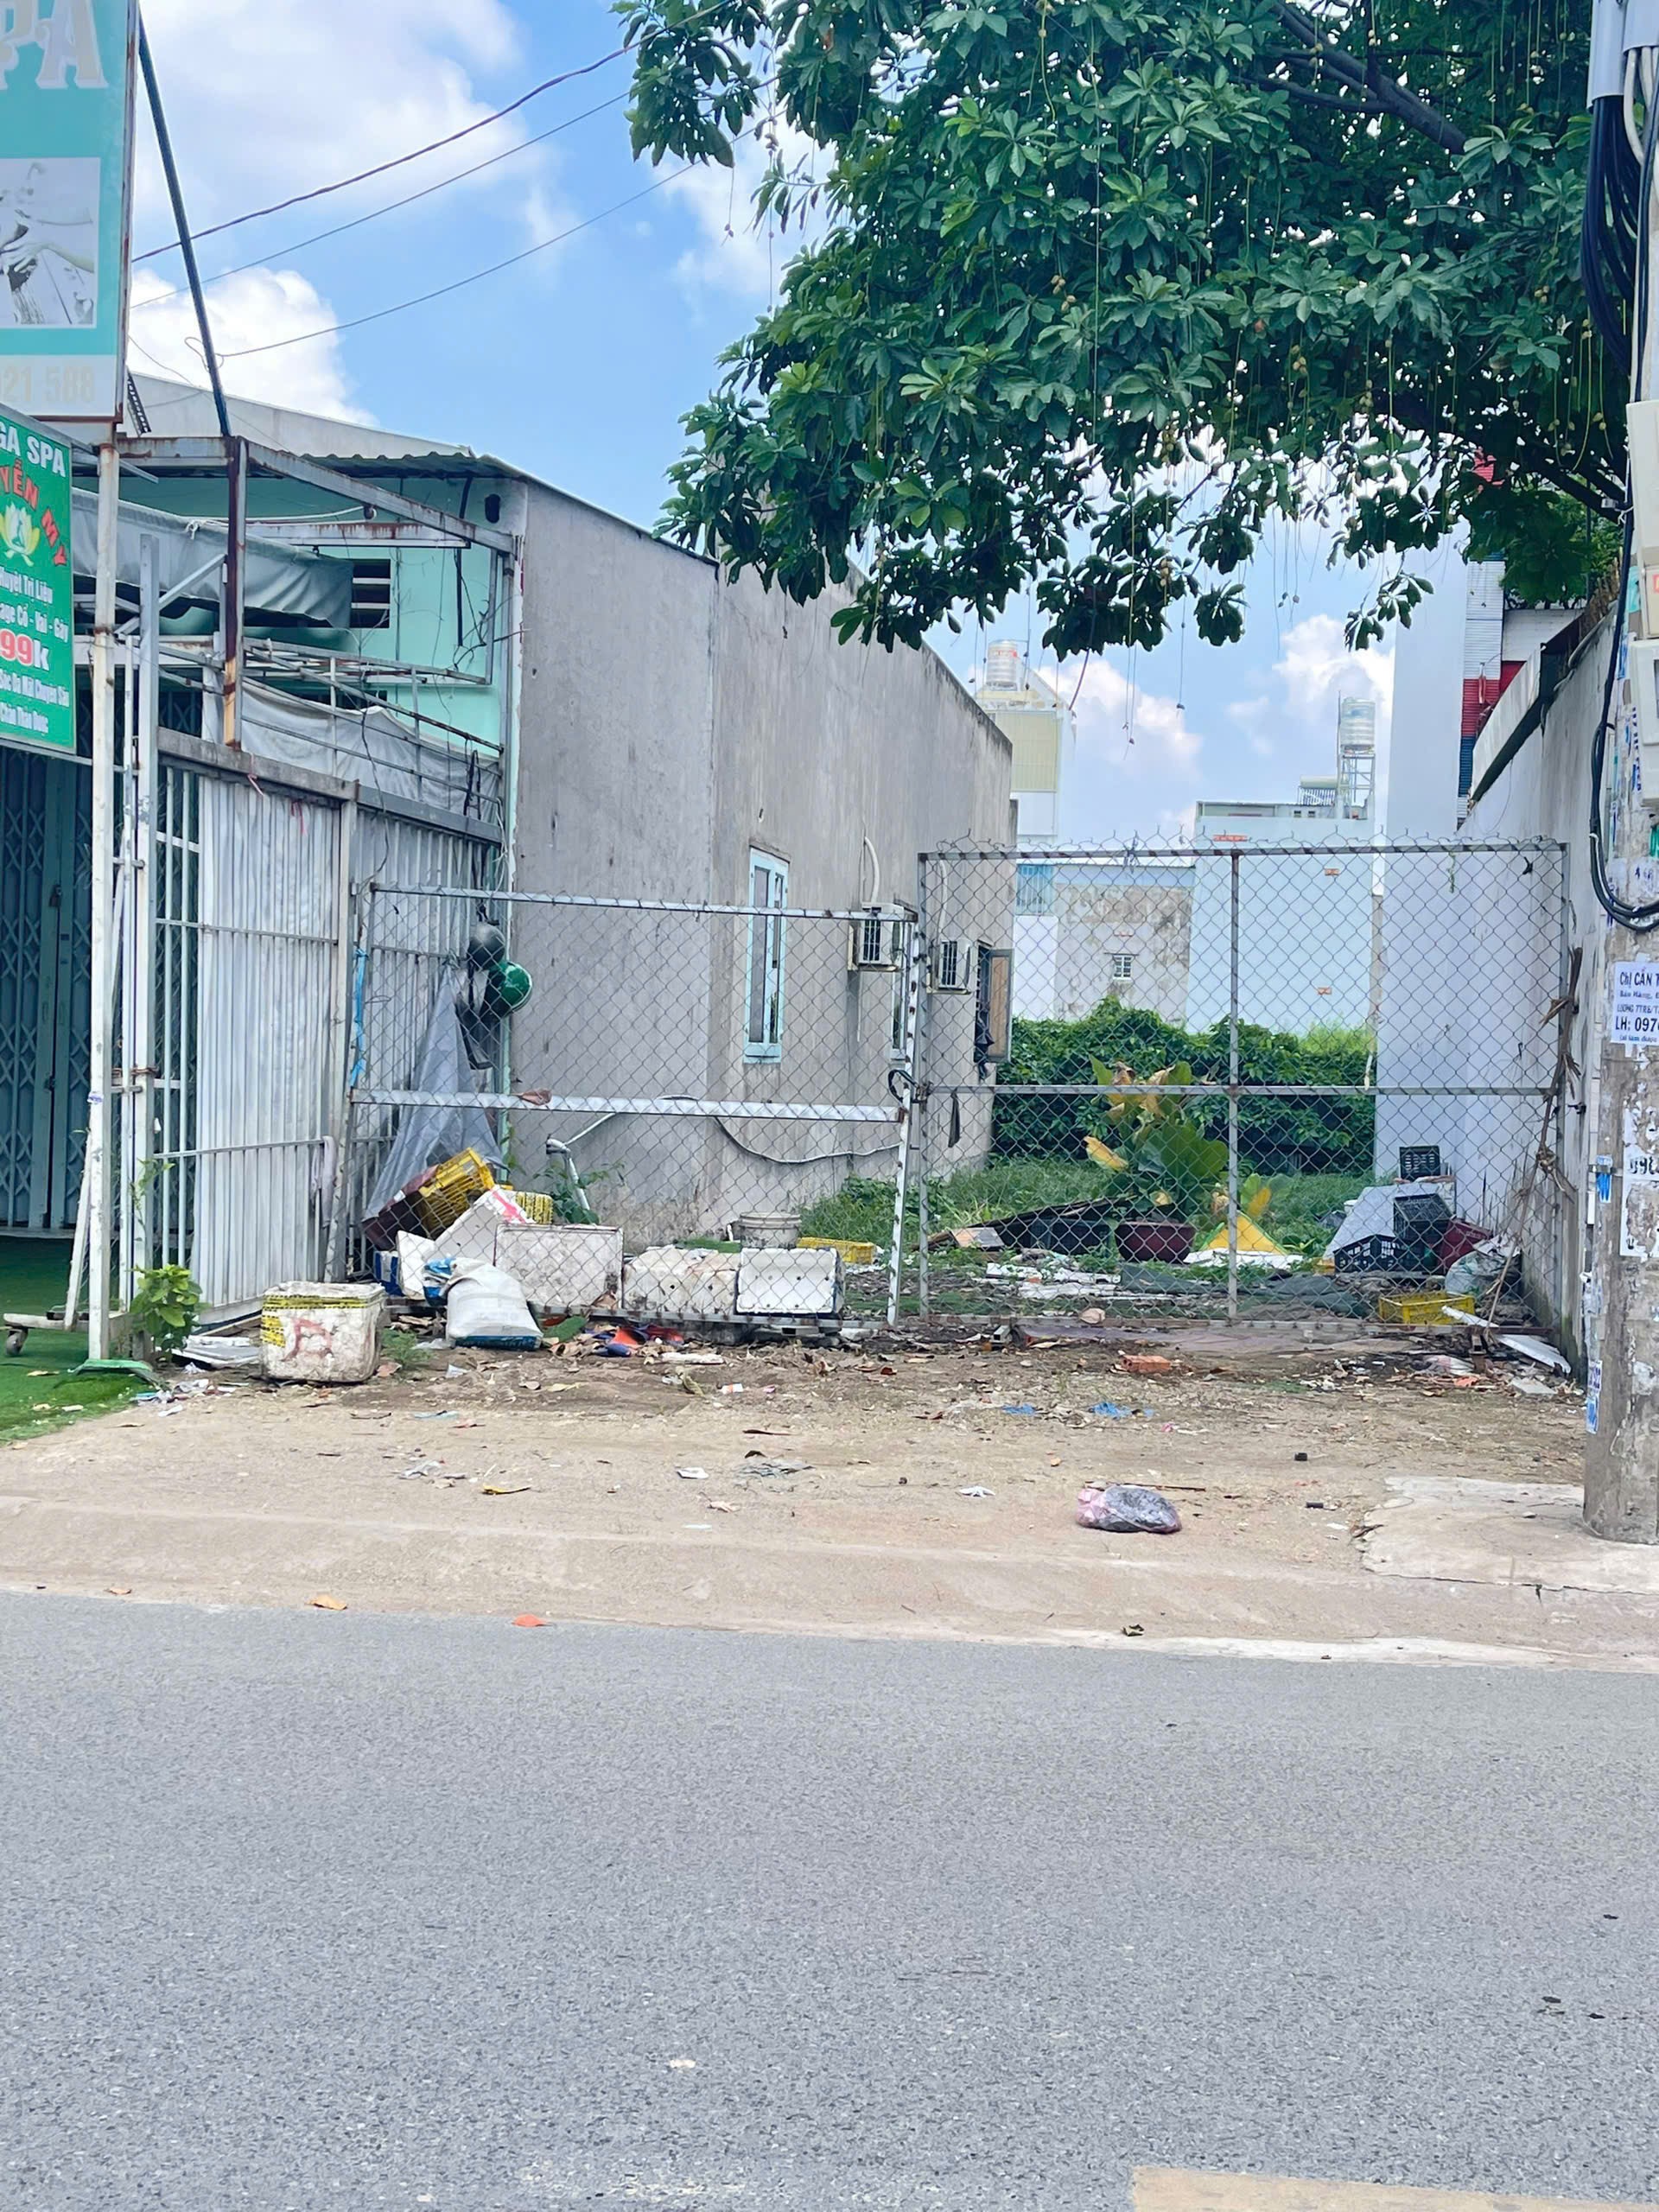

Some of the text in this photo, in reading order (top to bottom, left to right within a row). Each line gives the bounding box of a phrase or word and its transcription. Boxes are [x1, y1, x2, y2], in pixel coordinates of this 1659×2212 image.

[27, 435, 67, 478] SPA
[1615, 1016, 1659, 1033] LH: 097
